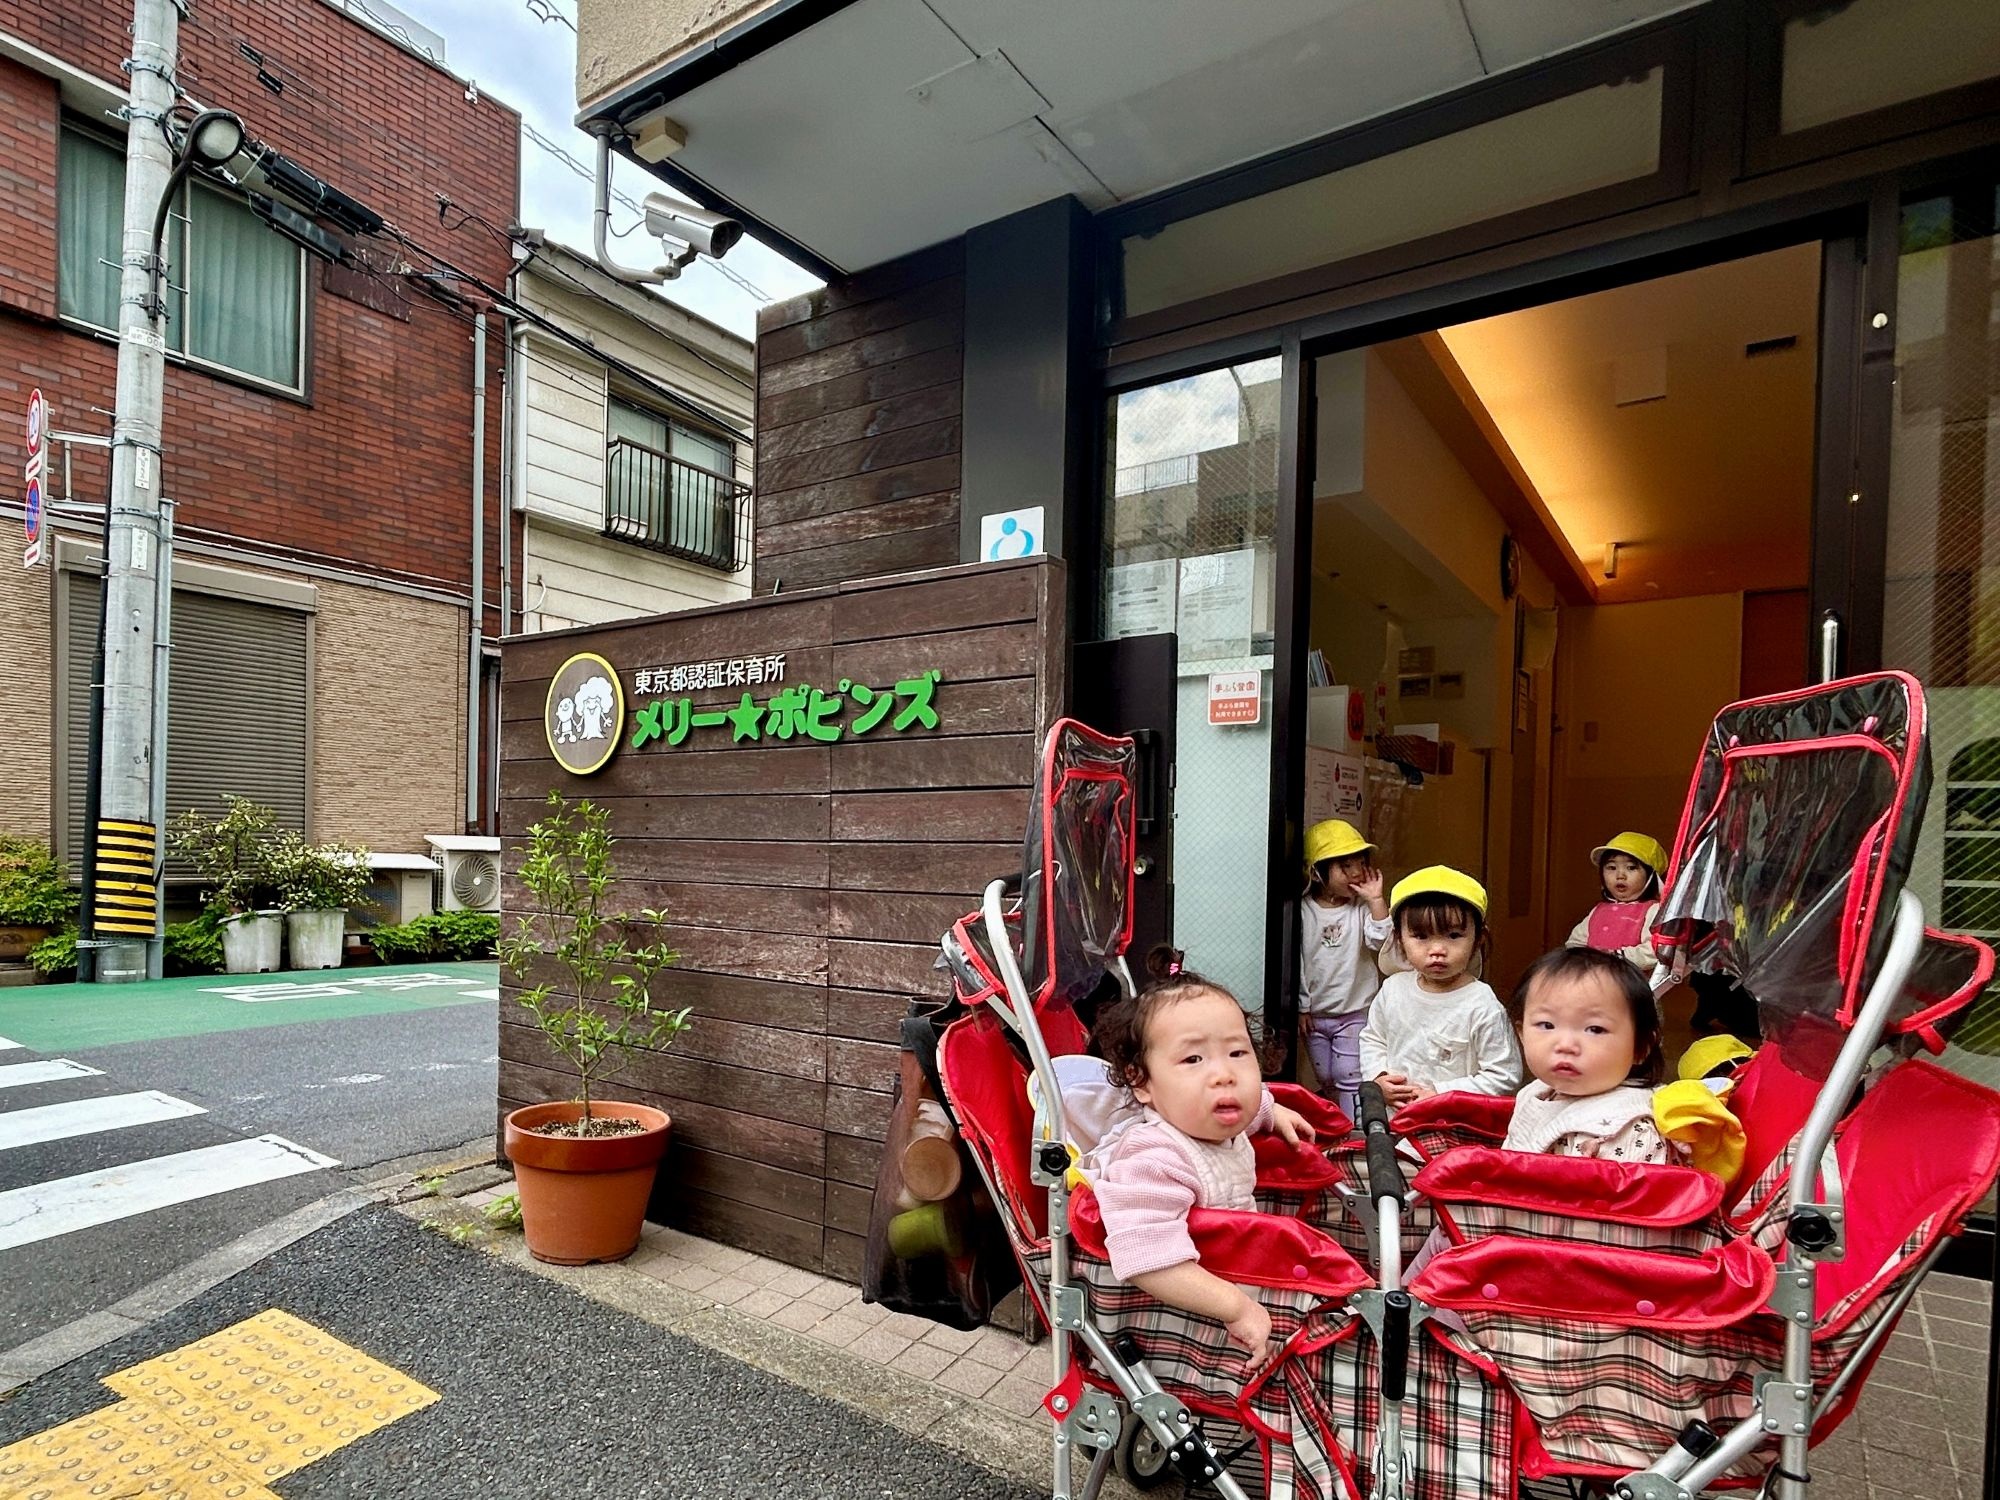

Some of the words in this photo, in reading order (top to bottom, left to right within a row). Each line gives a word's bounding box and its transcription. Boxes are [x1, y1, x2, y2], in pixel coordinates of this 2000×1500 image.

[634, 653, 786, 695] 東京都認証保育所
